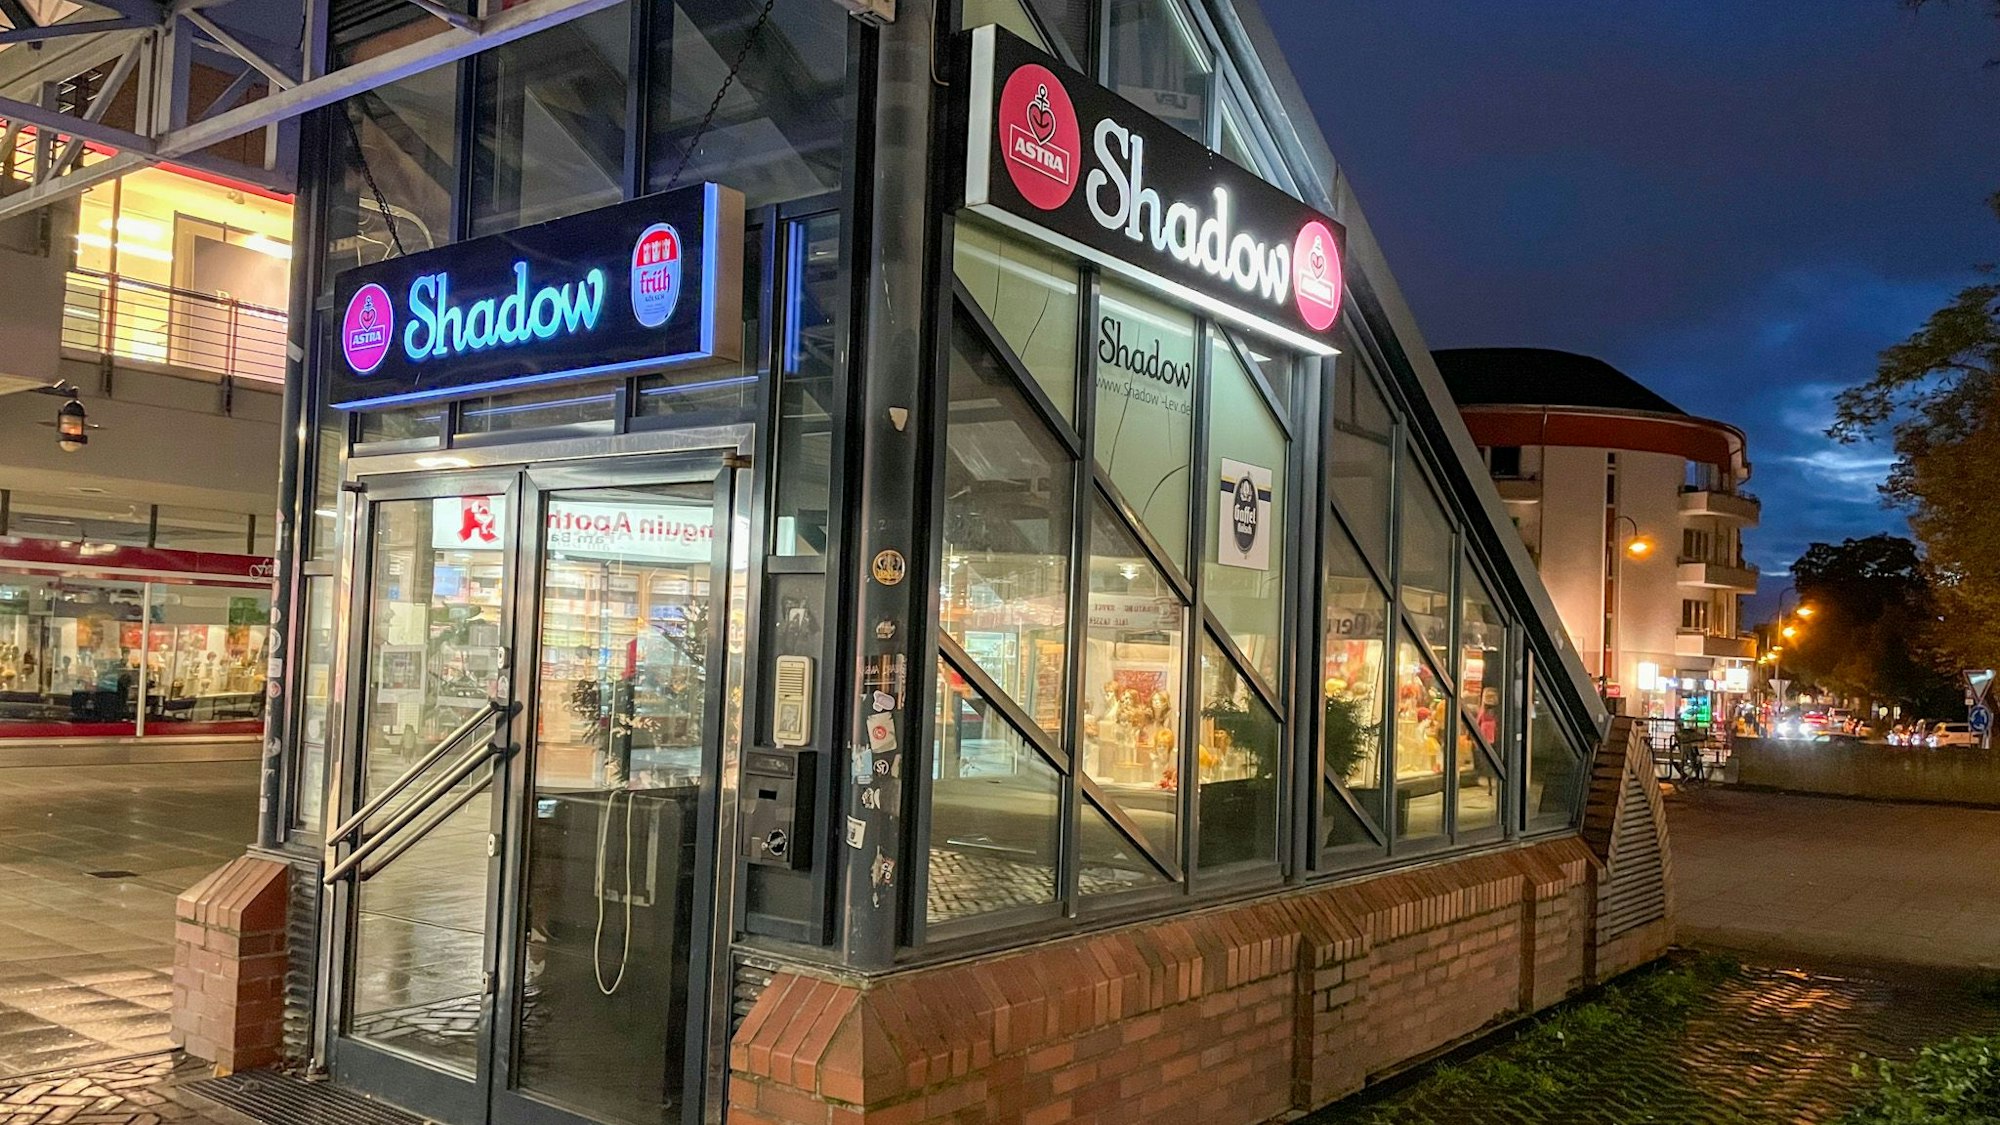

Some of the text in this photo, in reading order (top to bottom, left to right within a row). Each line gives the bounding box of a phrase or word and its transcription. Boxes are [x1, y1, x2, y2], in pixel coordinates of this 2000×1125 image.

[1014, 136, 1065, 174] ASTRA
[1086, 118, 1291, 304] Shadow
[640, 266, 671, 295] früh
[351, 330, 383, 346] ASTRA
[404, 261, 604, 360] Shadow
[1098, 315, 1191, 390] Shadow
